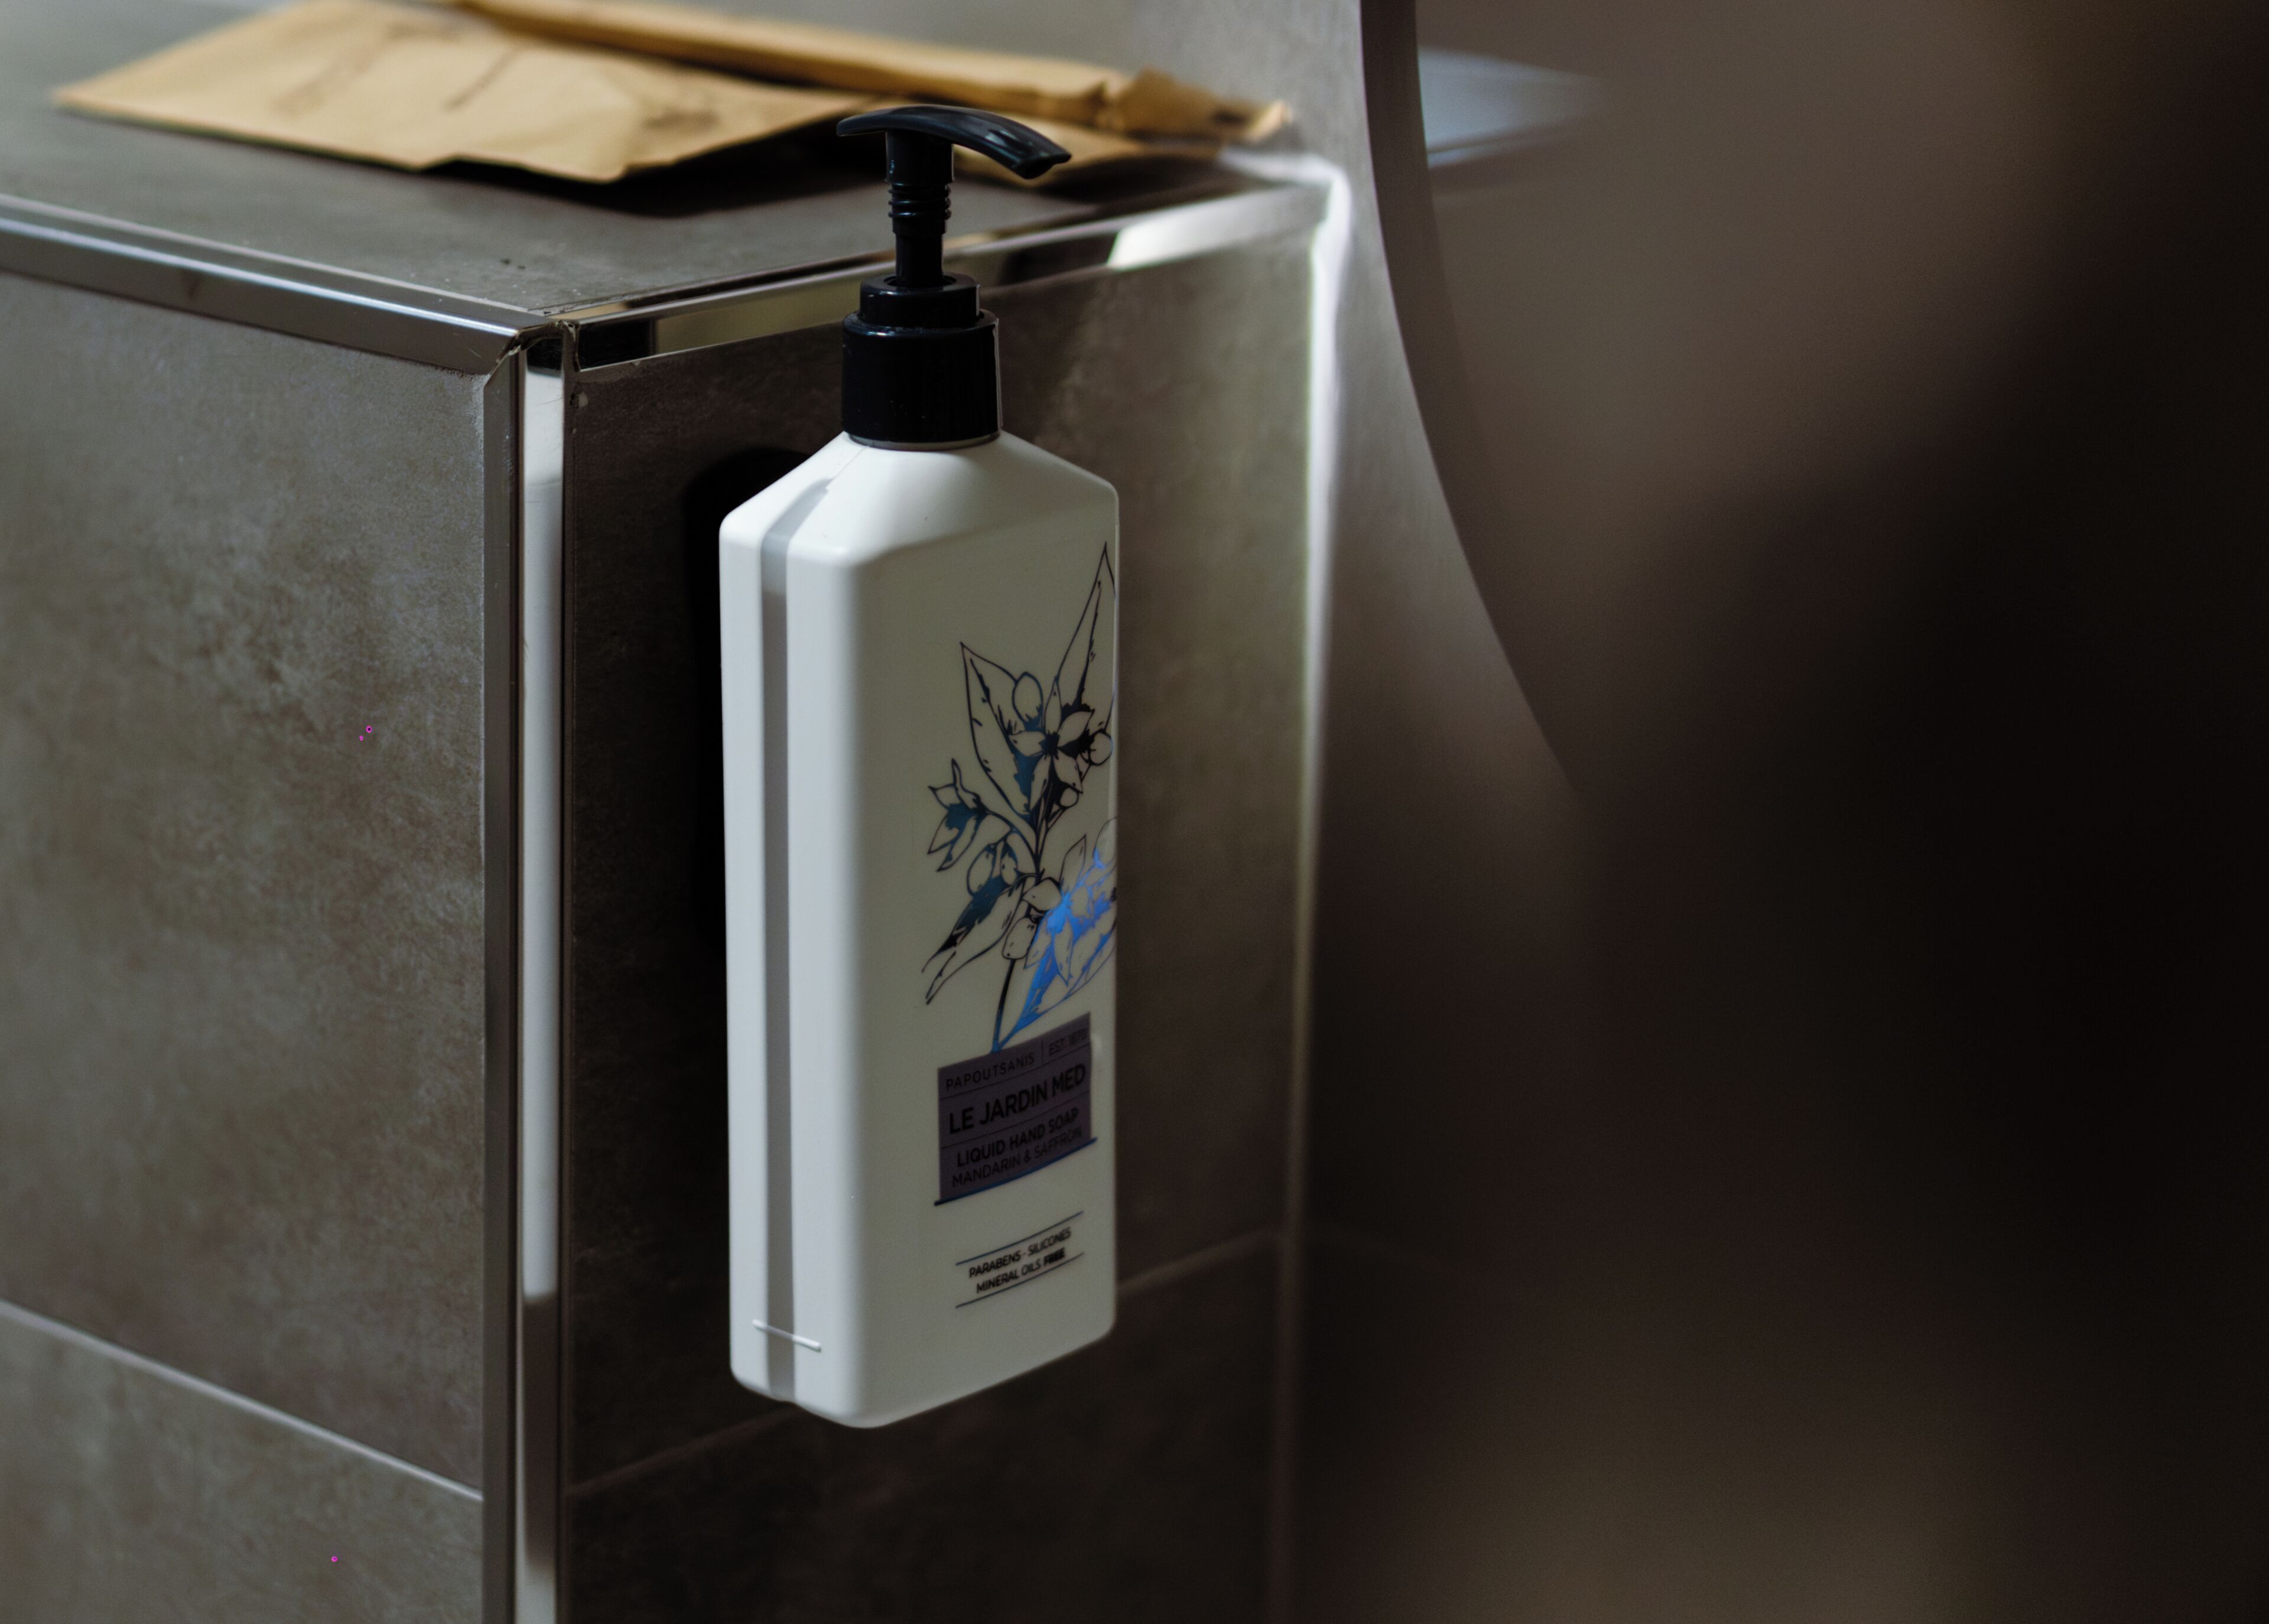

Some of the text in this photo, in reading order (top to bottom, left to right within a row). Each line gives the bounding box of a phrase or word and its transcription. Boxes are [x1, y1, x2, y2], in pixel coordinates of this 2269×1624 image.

[947, 1053, 1035, 1090] PAPOUTSANIS
[950, 1064, 1086, 1134] LE JARDIN MED
[953, 1127, 1082, 1188] MANDARIN & SAFFRON
[957, 1106, 1080, 1167] LIQUID HAND SOAP
[969, 1249, 1022, 1278] PARABENS
[1028, 1226, 1071, 1256] SILICONES
[977, 1247, 1065, 1294] MINERAL OILS FREE
